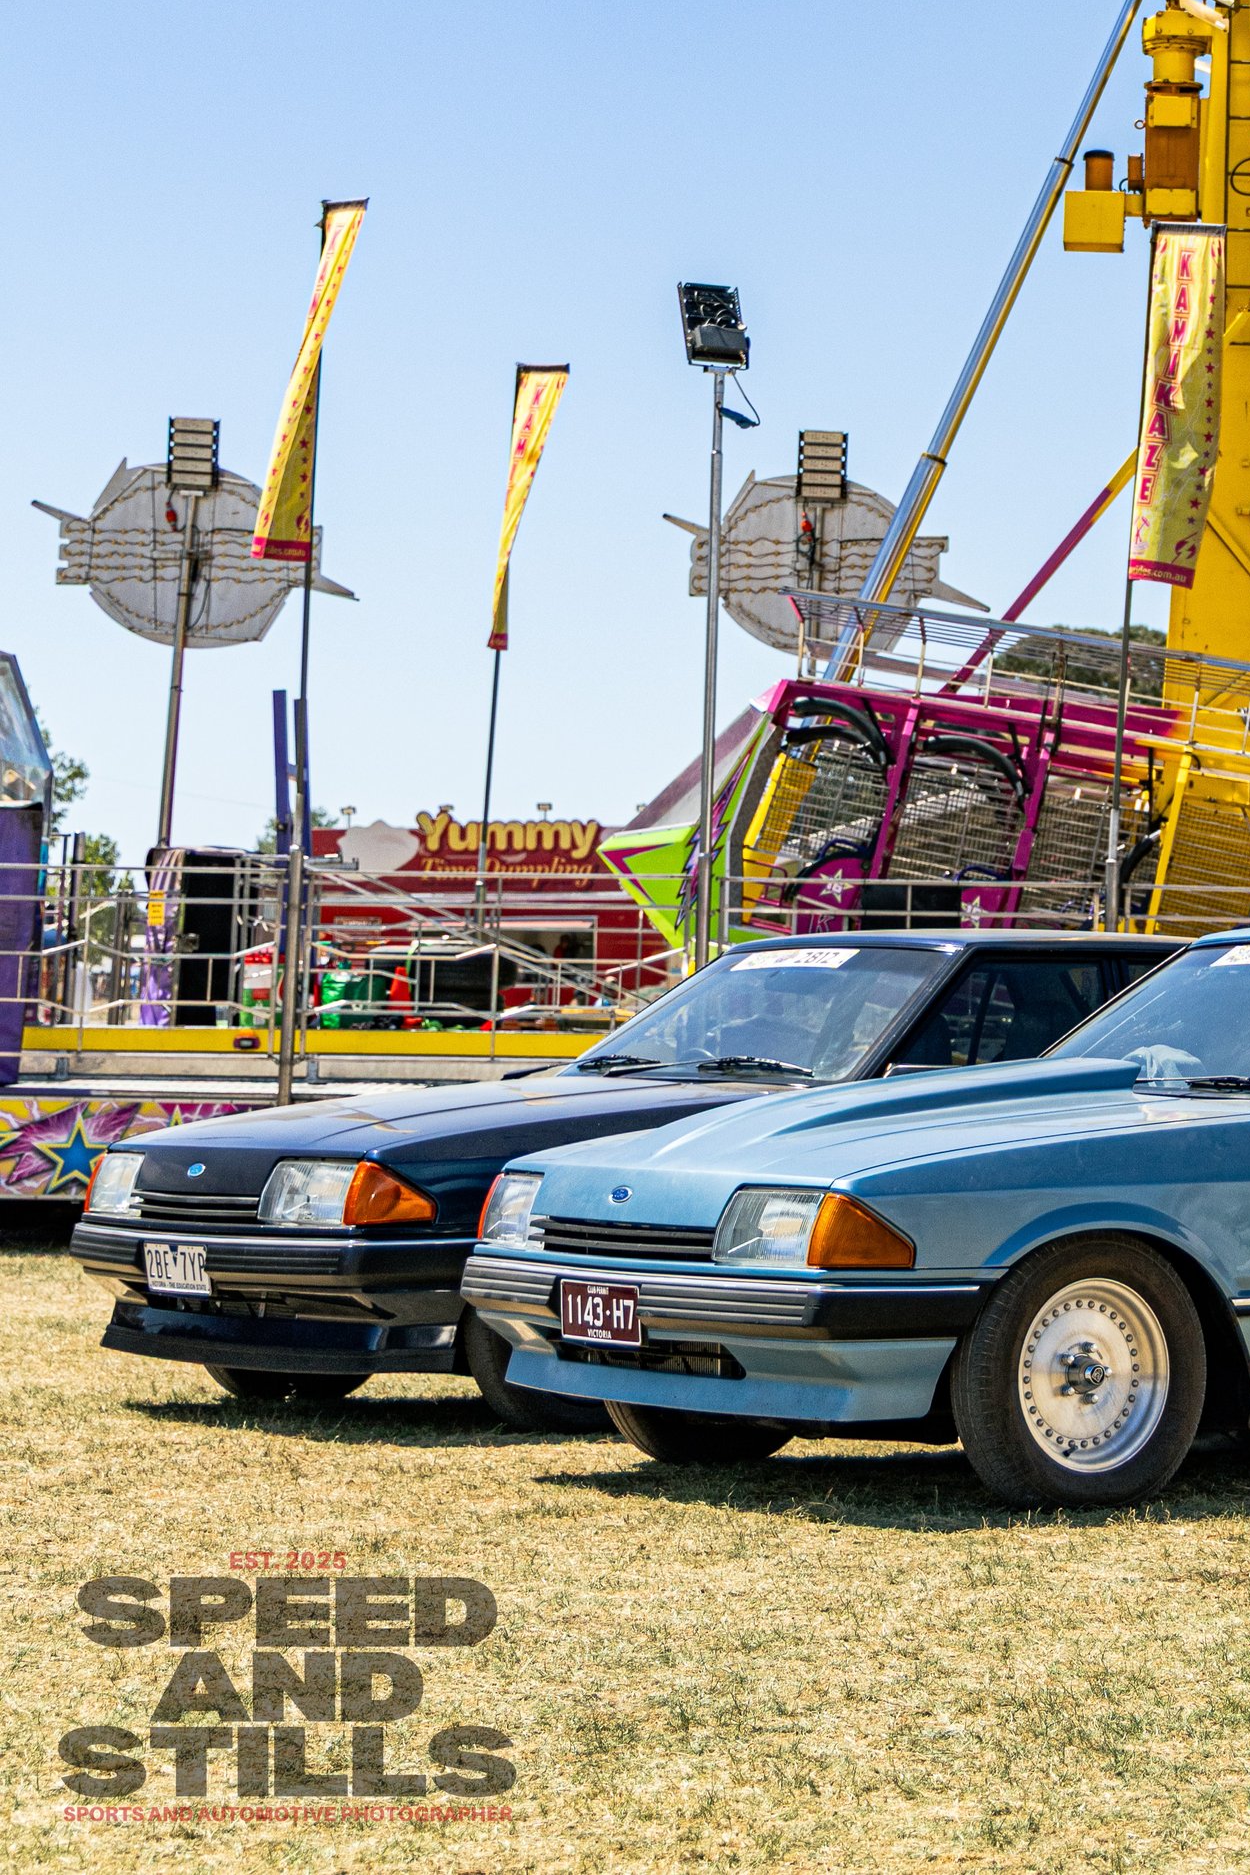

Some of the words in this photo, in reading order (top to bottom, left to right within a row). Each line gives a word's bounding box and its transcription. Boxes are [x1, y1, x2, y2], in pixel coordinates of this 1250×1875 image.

[1137, 249, 1196, 507] KAMIKAZE
[416, 811, 600, 860] Yummy
[147, 1249, 172, 1280] 2BE
[179, 1252, 205, 1282] 7YP
[587, 1329, 612, 1339] VICTORIA
